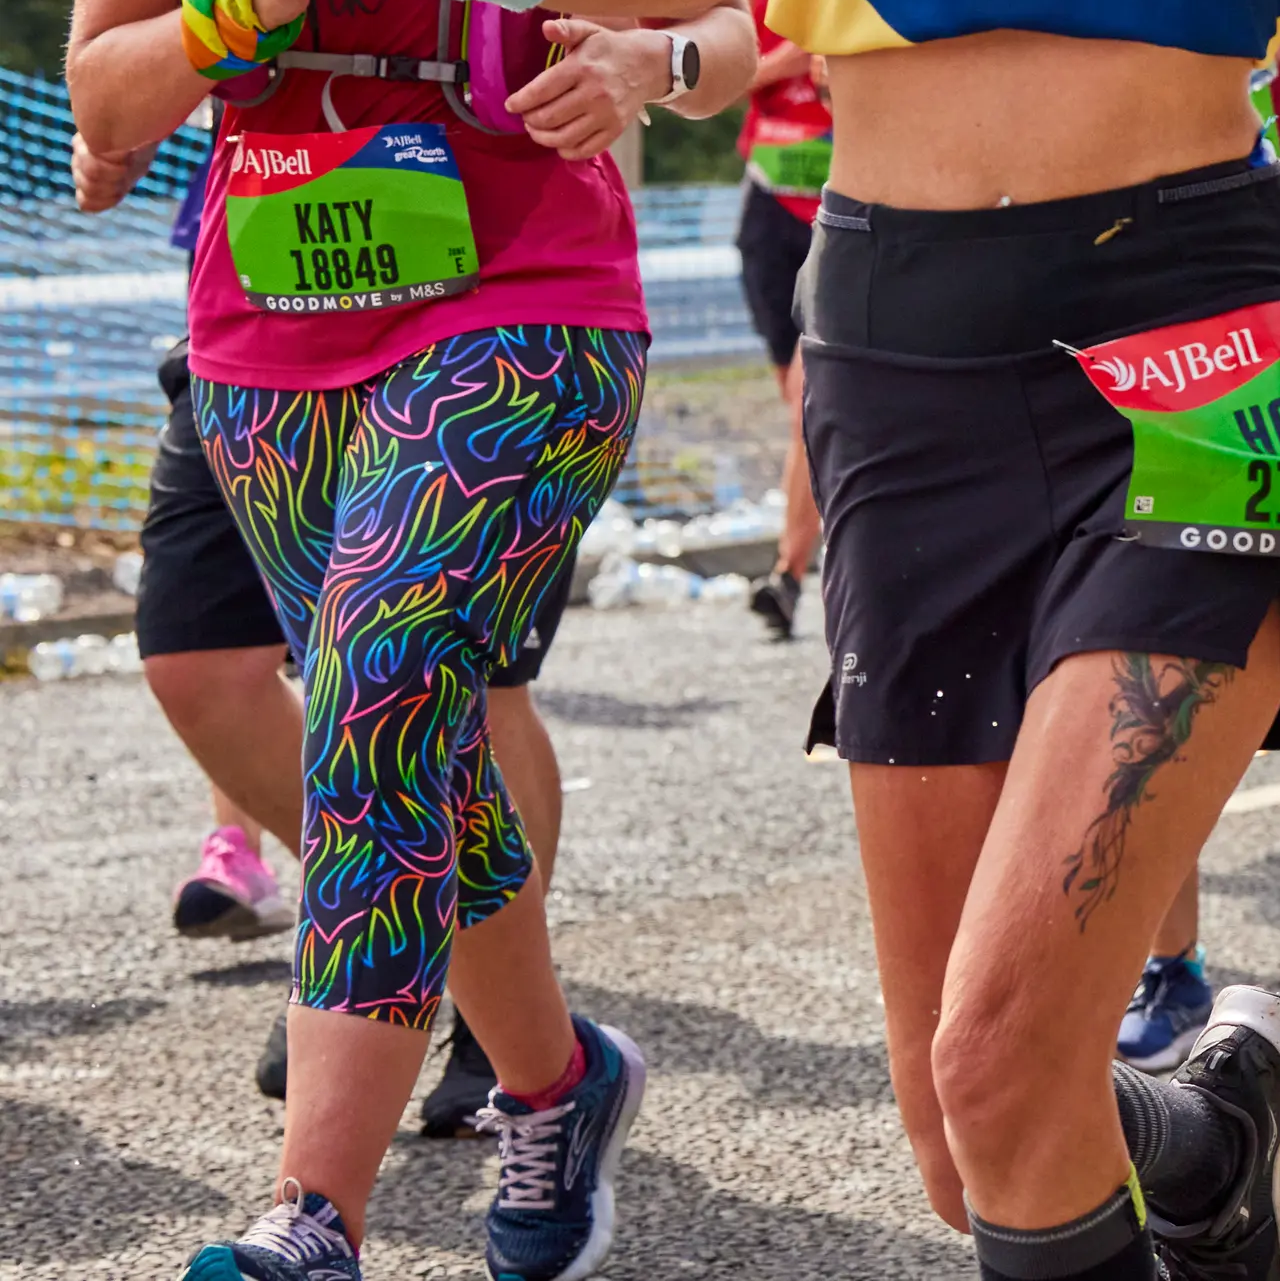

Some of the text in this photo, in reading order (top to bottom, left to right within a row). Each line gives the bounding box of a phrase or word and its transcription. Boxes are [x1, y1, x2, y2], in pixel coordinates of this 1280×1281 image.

[244, 149, 312, 179] AJBell
[294, 199, 373, 244] KATY
[290, 244, 399, 291] 18849
[455, 257, 465, 274] E
[266, 292, 383, 311] GOODMOVE
[409, 282, 445, 300] M&S
[1140, 328, 1262, 393] AJBell
